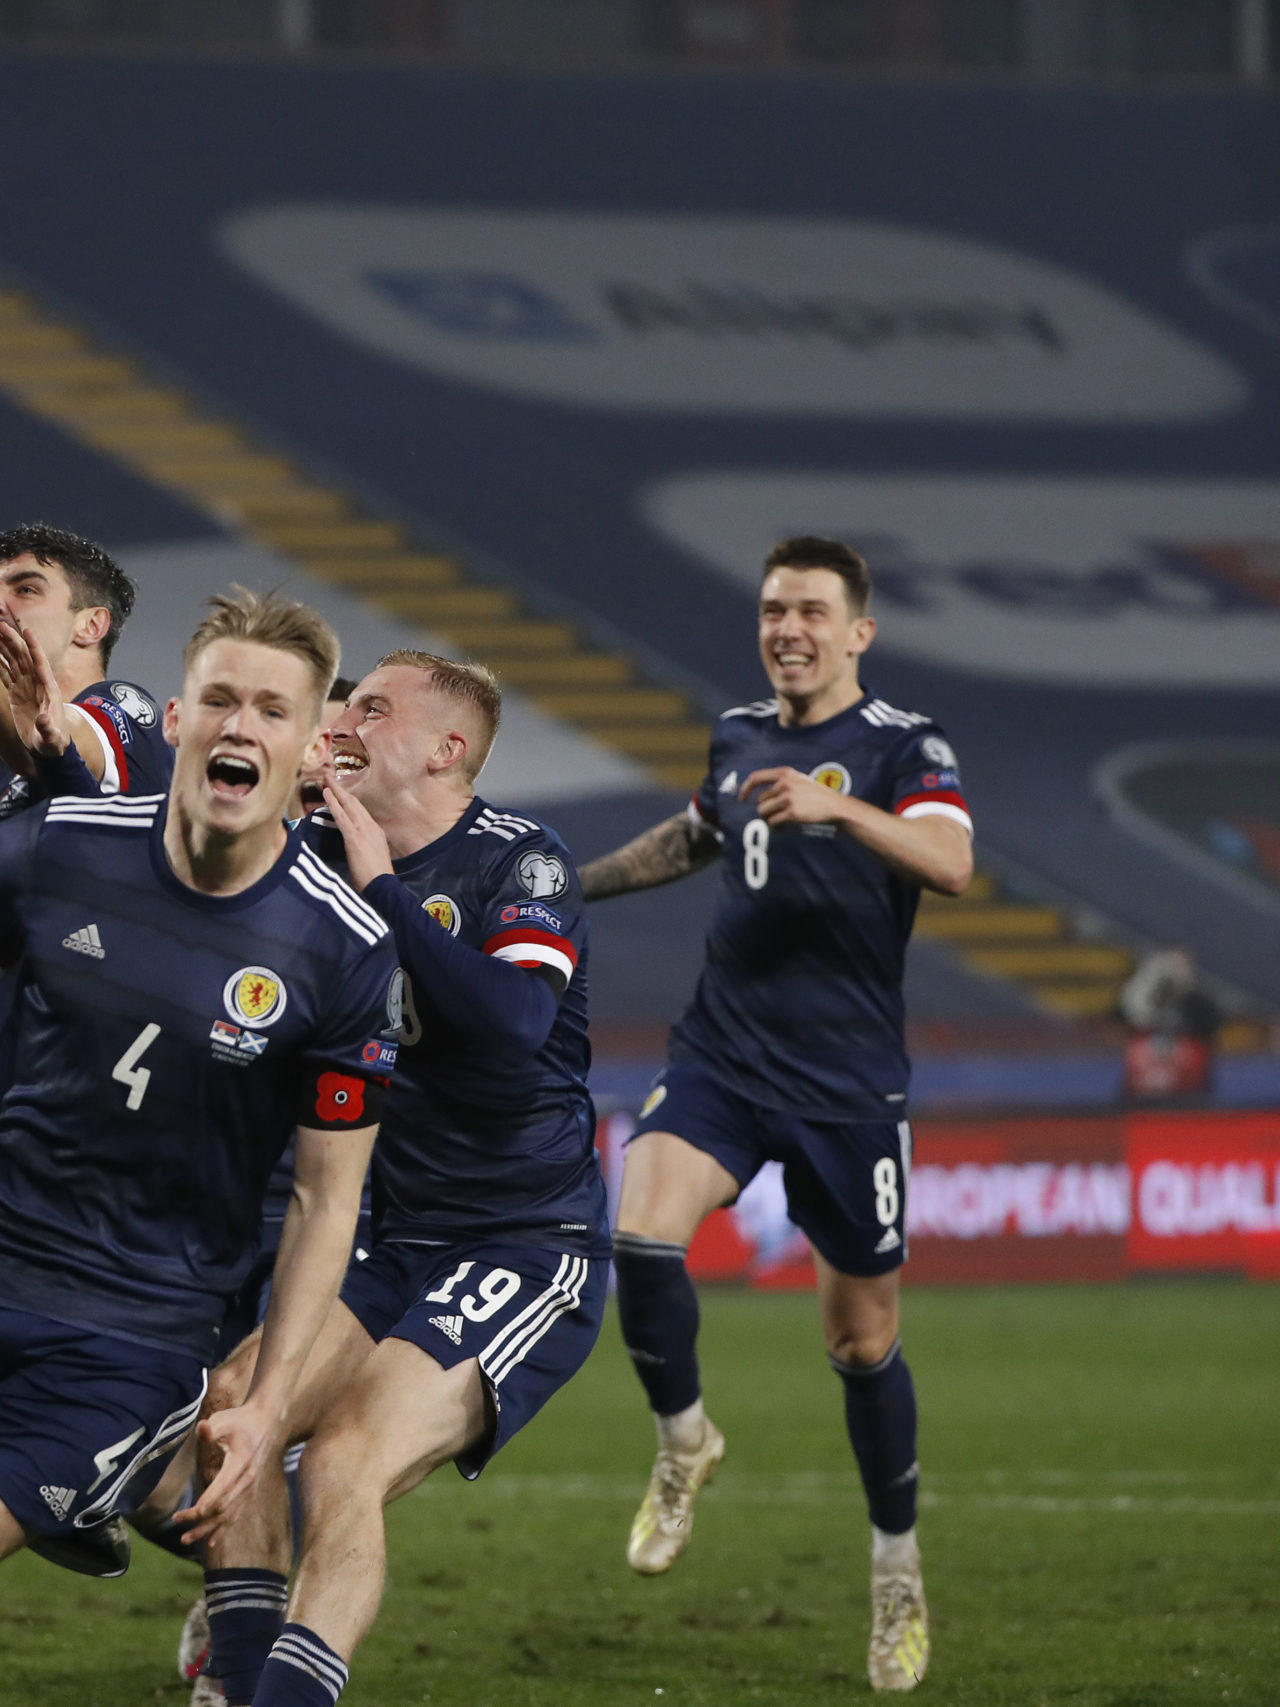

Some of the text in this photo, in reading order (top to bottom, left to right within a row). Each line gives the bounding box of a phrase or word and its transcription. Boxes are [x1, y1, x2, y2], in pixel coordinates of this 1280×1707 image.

[101, 702, 129, 745] RESPECT
[742, 818, 770, 891] 8
[61, 937, 106, 959] adidas
[111, 1022, 162, 1112] 4
[872, 1157, 899, 1227] 8
[1138, 1160, 1280, 1240] QUAL
[425, 1261, 522, 1323] 19
[428, 1317, 463, 1346] adidas
[85, 1425, 147, 1495] 4
[39, 1485, 67, 1521] adidas
